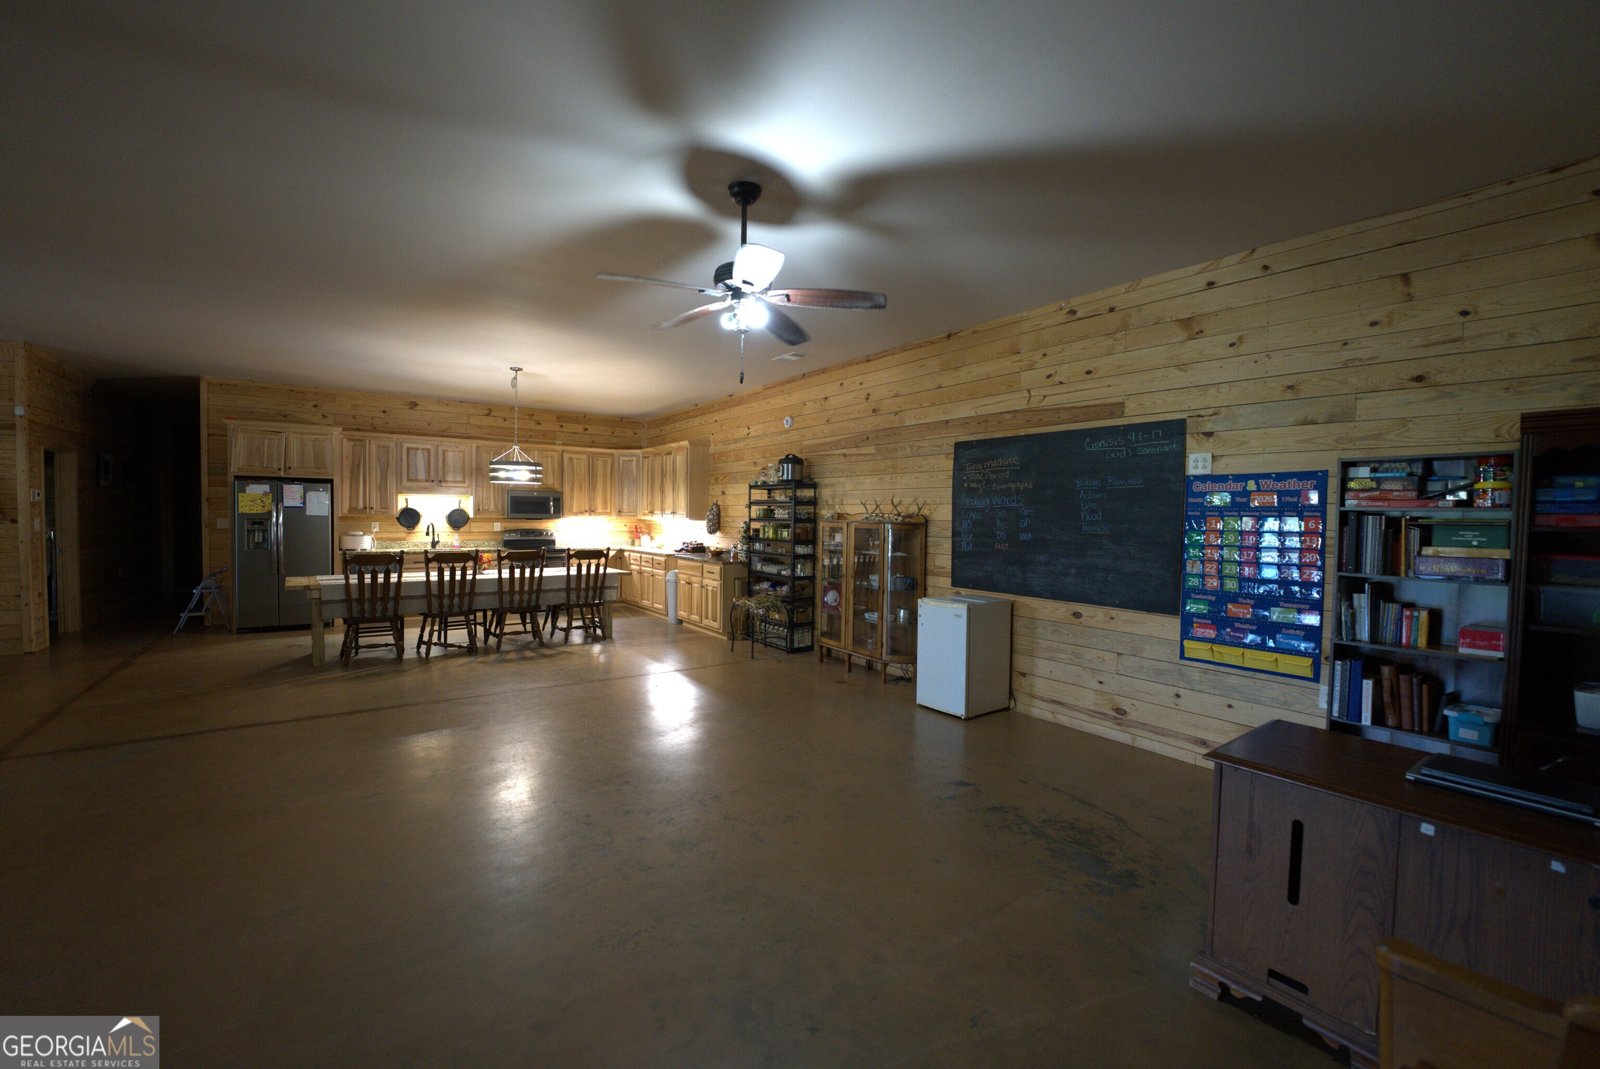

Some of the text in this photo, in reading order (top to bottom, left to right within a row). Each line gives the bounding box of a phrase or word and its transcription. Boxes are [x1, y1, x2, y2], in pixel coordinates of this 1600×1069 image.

[1192, 479, 1318, 492] Calendar & Weather
[1308, 520, 1316, 529] 6
[1209, 534, 1216, 543] 8
[1227, 534, 1234, 543] 9
[1244, 535, 1256, 544] 10
[1305, 537, 1318, 546] 13
[1242, 551, 1254, 560] 17
[1304, 553, 1316, 562] 20
[1205, 564, 1217, 573] 22
[1225, 565, 1236, 574] 23
[1189, 577, 1200, 586] 28
[1225, 580, 1236, 589] 30
